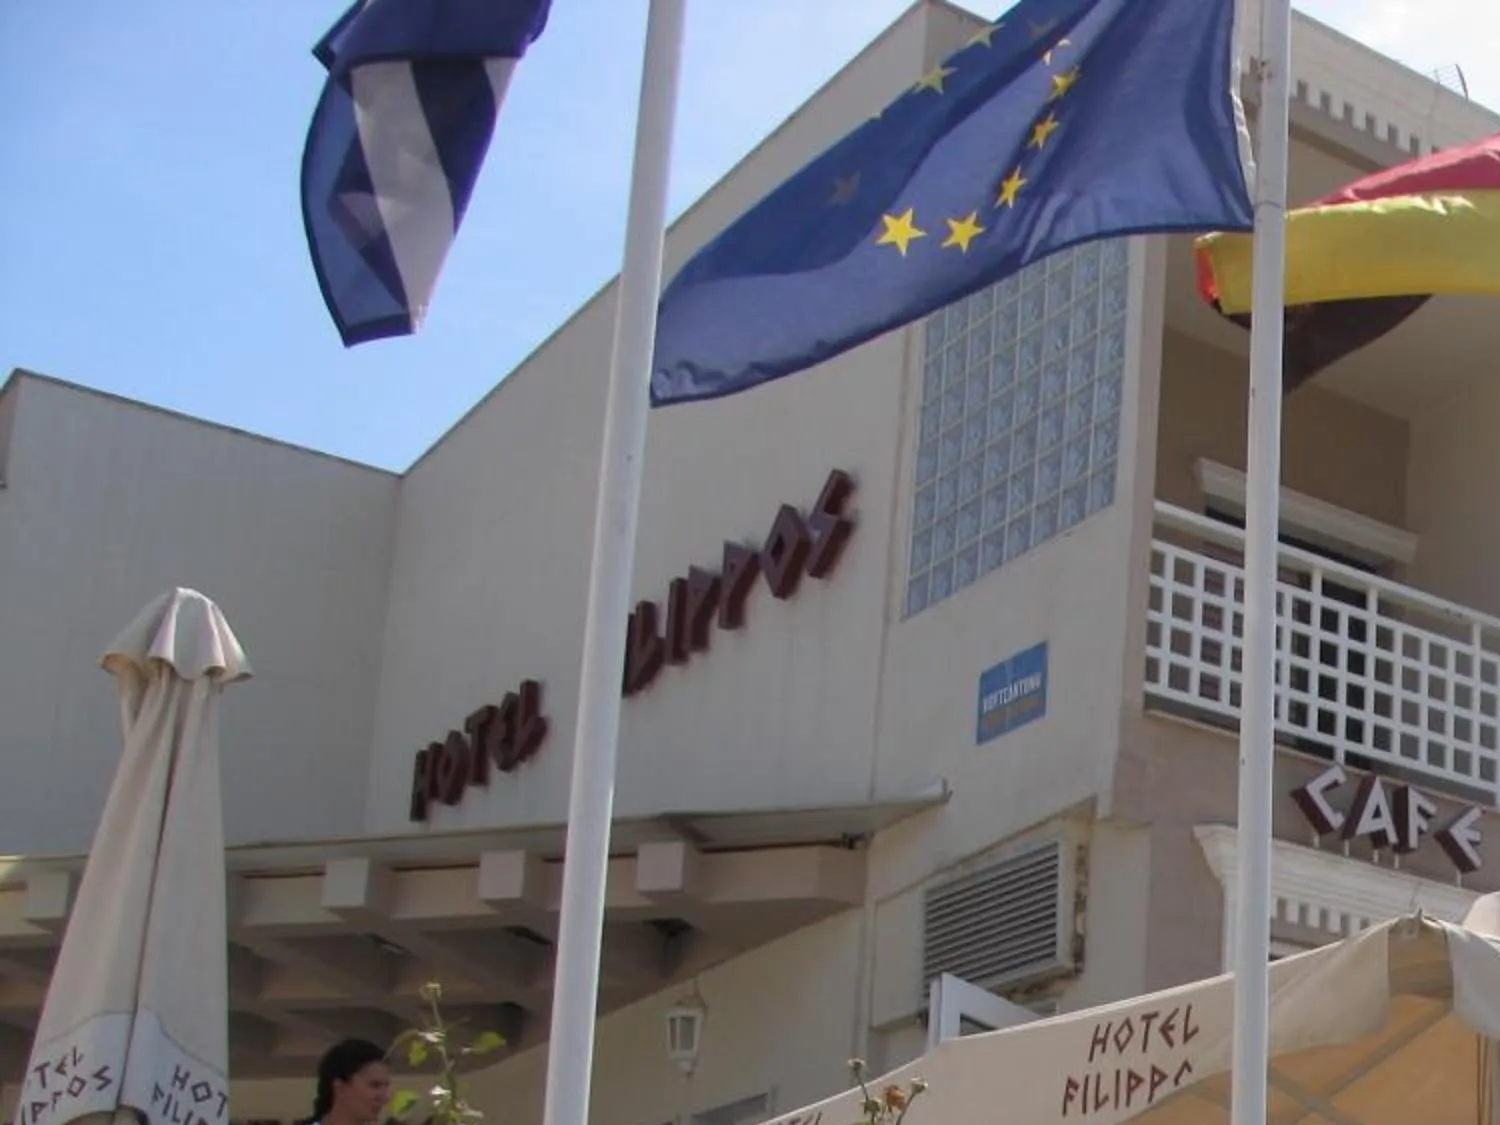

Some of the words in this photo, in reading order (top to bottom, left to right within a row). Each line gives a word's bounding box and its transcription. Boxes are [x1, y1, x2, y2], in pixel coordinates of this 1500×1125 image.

[409, 678, 548, 822] HOTEL
[621, 469, 857, 698] LIPPOS
[1294, 764, 1485, 873] CAFE
[30, 1046, 84, 1090] TEL
[1088, 1003, 1200, 1063] HOTEL
